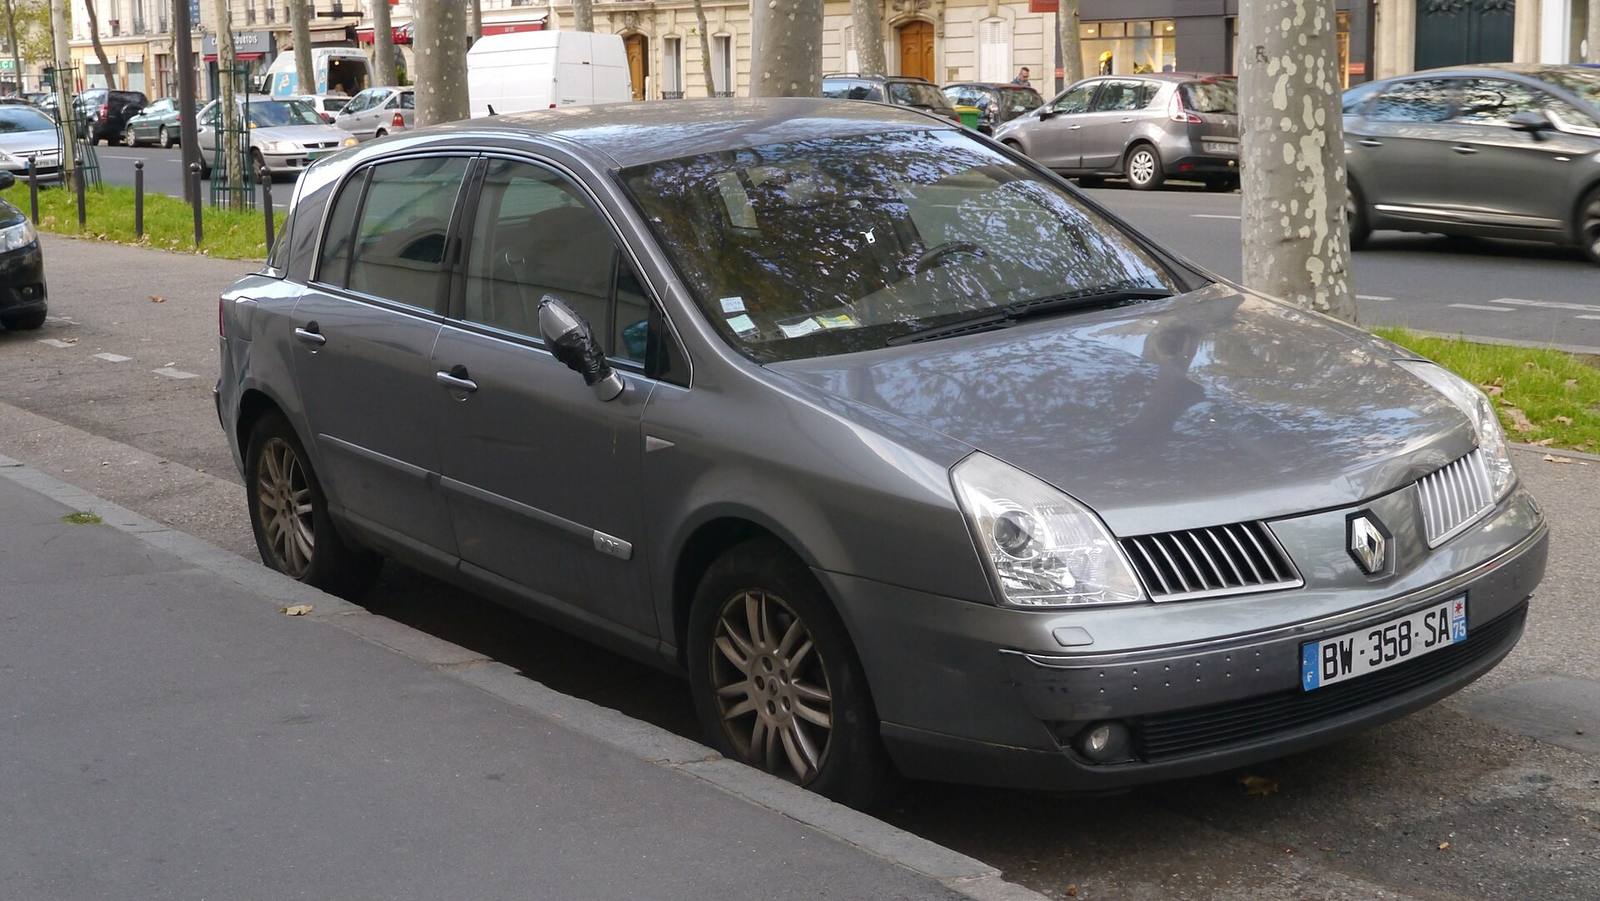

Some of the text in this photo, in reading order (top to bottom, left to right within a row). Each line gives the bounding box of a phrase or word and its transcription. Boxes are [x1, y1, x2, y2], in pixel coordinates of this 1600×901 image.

[1453, 620, 1466, 637] 75
[1323, 608, 1451, 680] BW-358-SA
[1307, 671, 1314, 682] F
